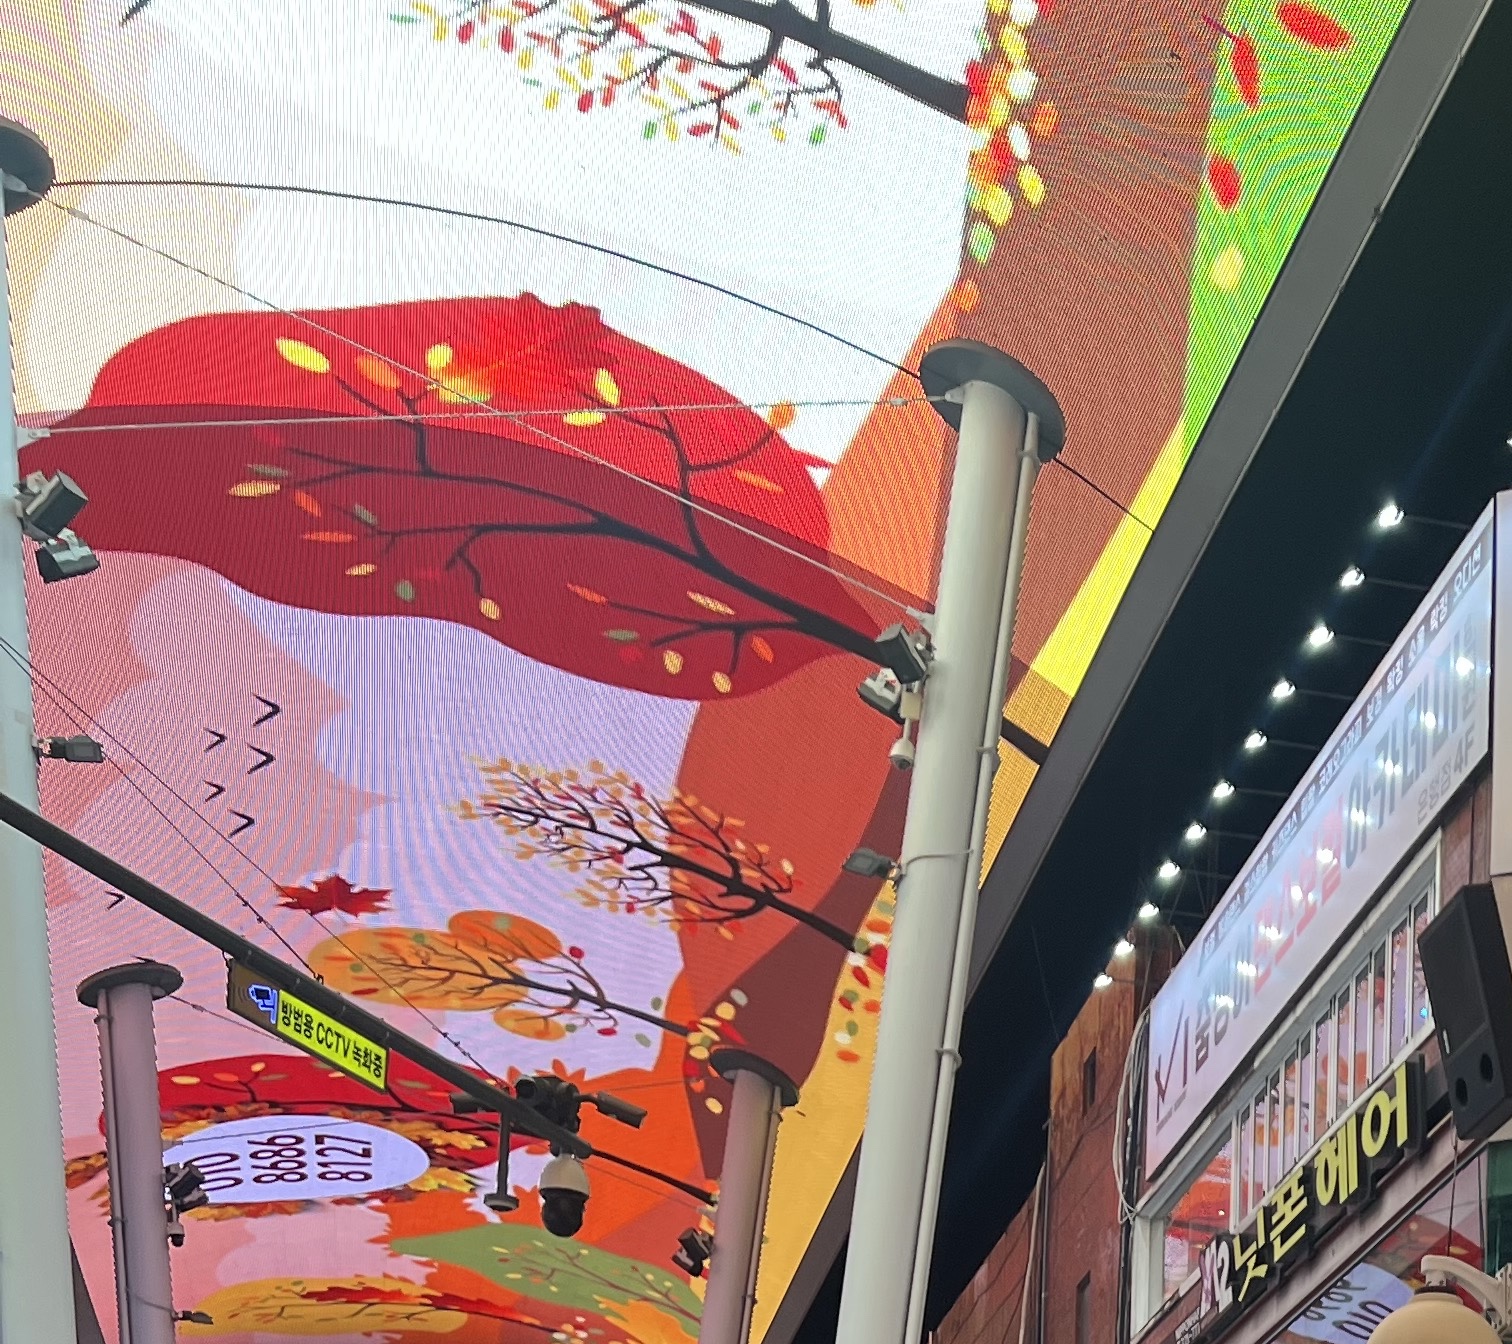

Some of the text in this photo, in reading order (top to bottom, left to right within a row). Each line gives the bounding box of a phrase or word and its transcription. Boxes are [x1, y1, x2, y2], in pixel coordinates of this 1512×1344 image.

[1453, 727, 1476, 775] 4F
[281, 1000, 383, 1078] 방범용 CCTV 녹화중
[315, 1134, 373, 1183] 8127
